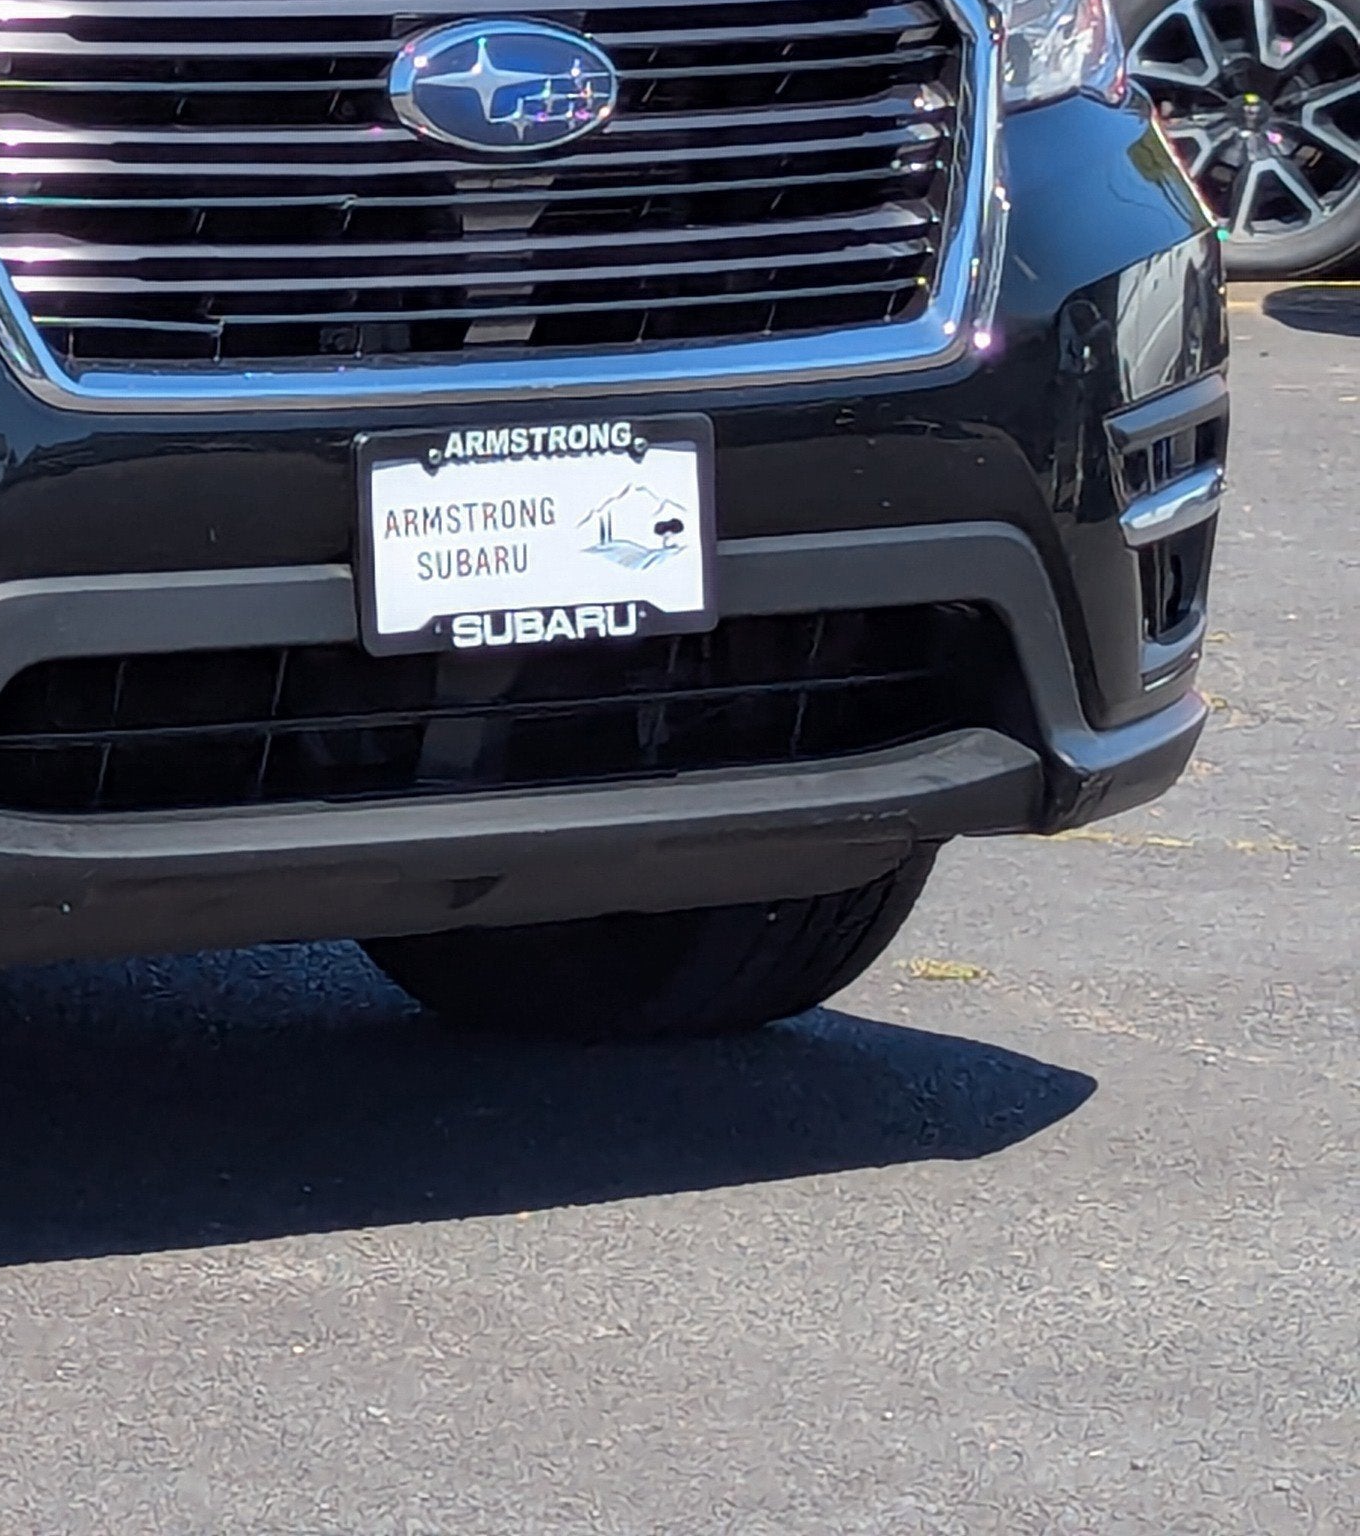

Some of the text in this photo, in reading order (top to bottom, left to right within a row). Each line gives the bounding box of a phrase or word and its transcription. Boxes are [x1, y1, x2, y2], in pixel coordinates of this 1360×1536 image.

[444, 422, 632, 459] ARMSTRONG
[384, 497, 556, 539] ARMSTRONG
[417, 543, 529, 581] SUBARU
[452, 603, 637, 649] SUBARU
